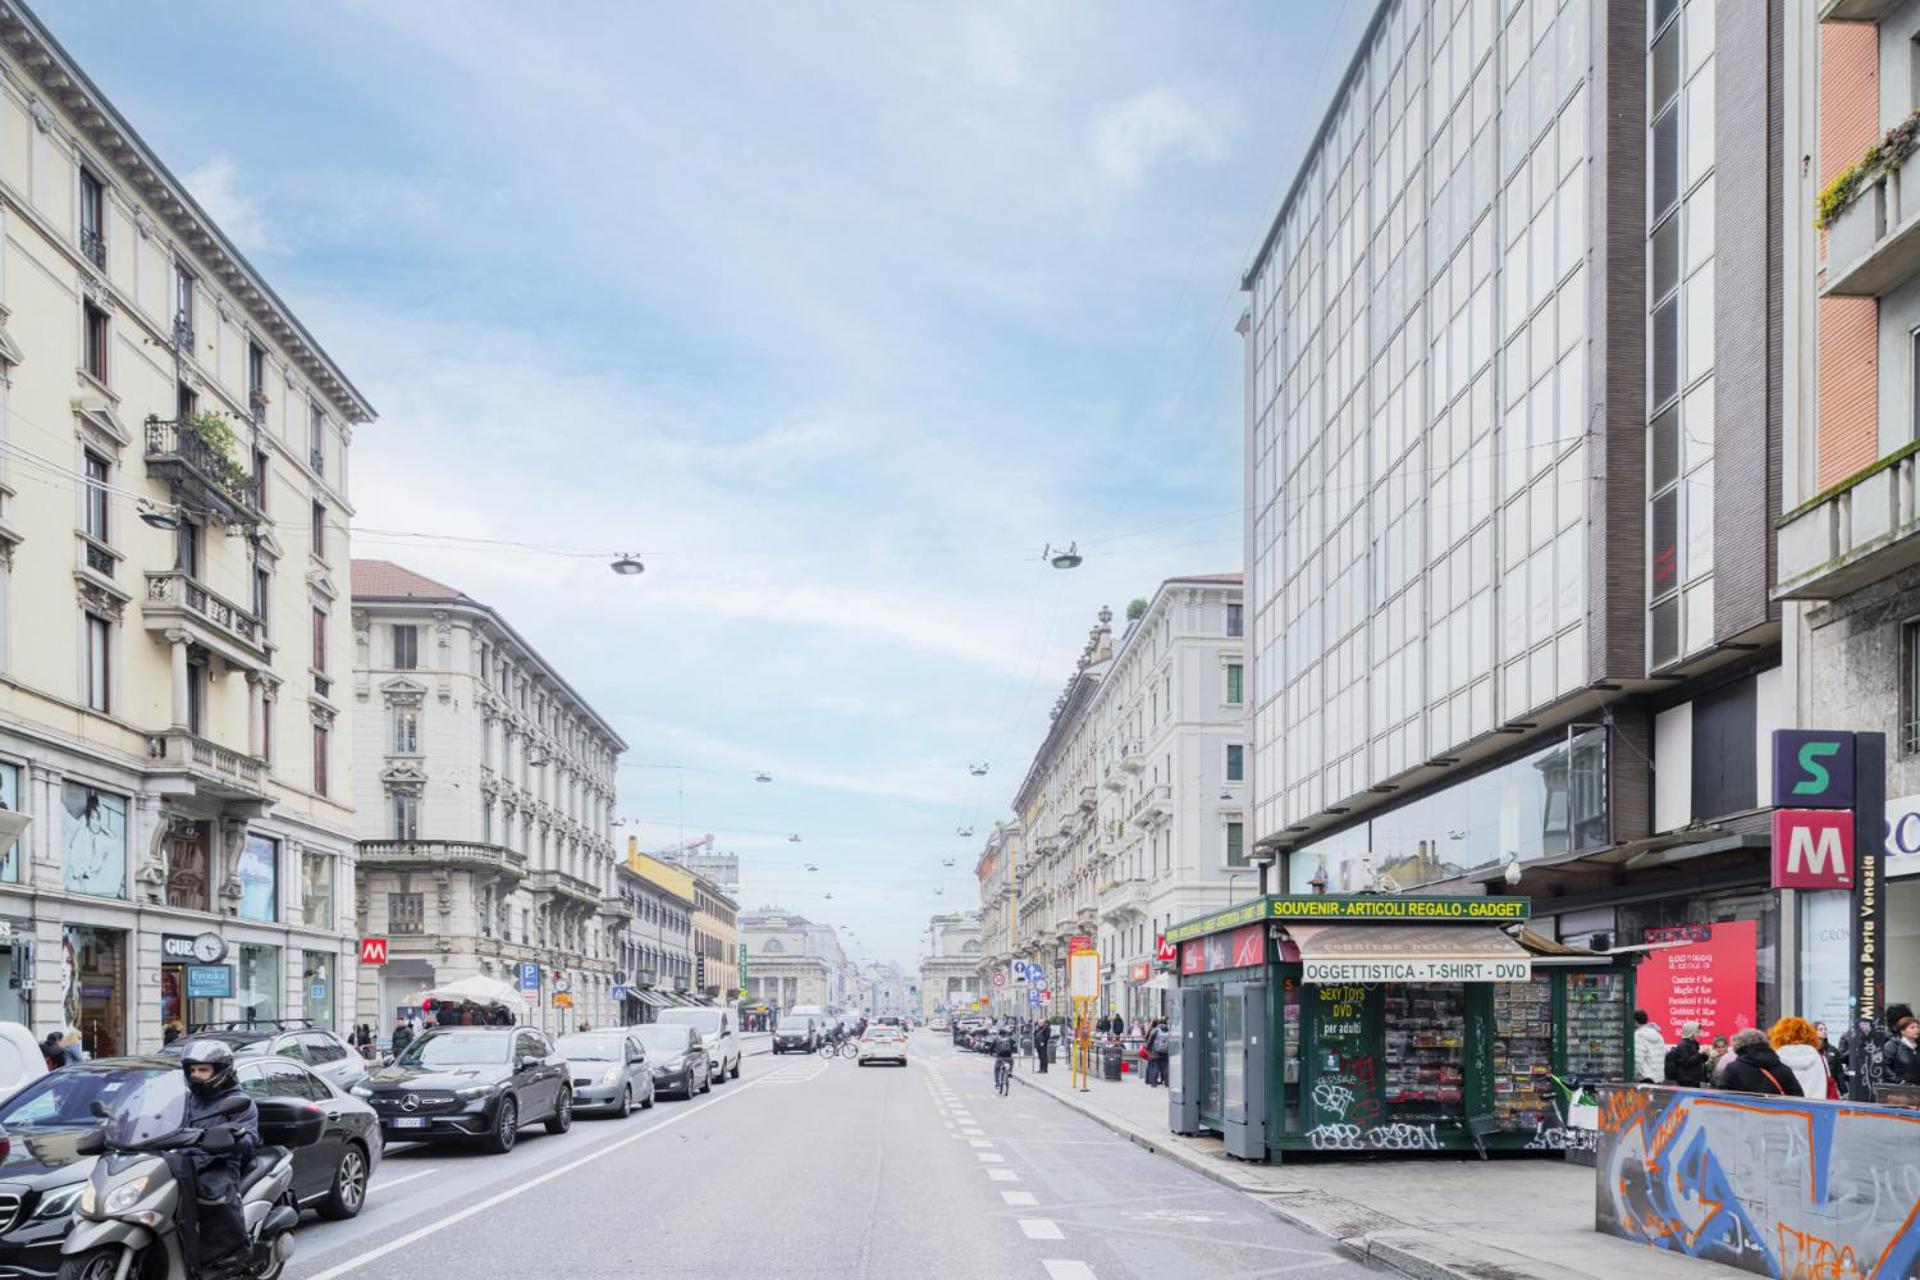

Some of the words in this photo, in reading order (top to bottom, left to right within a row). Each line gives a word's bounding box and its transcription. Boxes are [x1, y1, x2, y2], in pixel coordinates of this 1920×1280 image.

[1792, 742, 1841, 794] S
[1786, 826, 1846, 874] M
[1860, 855, 1875, 917] Venezia
[1274, 901, 1339, 915] SOUVENIR
[1346, 902, 1405, 916] ARTICOLI
[1408, 902, 1462, 916] REGALO
[1468, 903, 1523, 916] GADGET
[165, 938, 194, 956] GUE
[1860, 920, 1875, 963] Porta
[1306, 964, 1416, 979] OGGETTISTICA
[1427, 964, 1483, 979] T-SHIRT
[1496, 964, 1526, 979] DVD
[1343, 986, 1366, 1001] TOYS
[1860, 967, 1875, 1020] Milano
[1333, 1004, 1353, 1018] DVD
[1324, 1024, 1338, 1037] per
[1339, 1021, 1362, 1034] adulti
